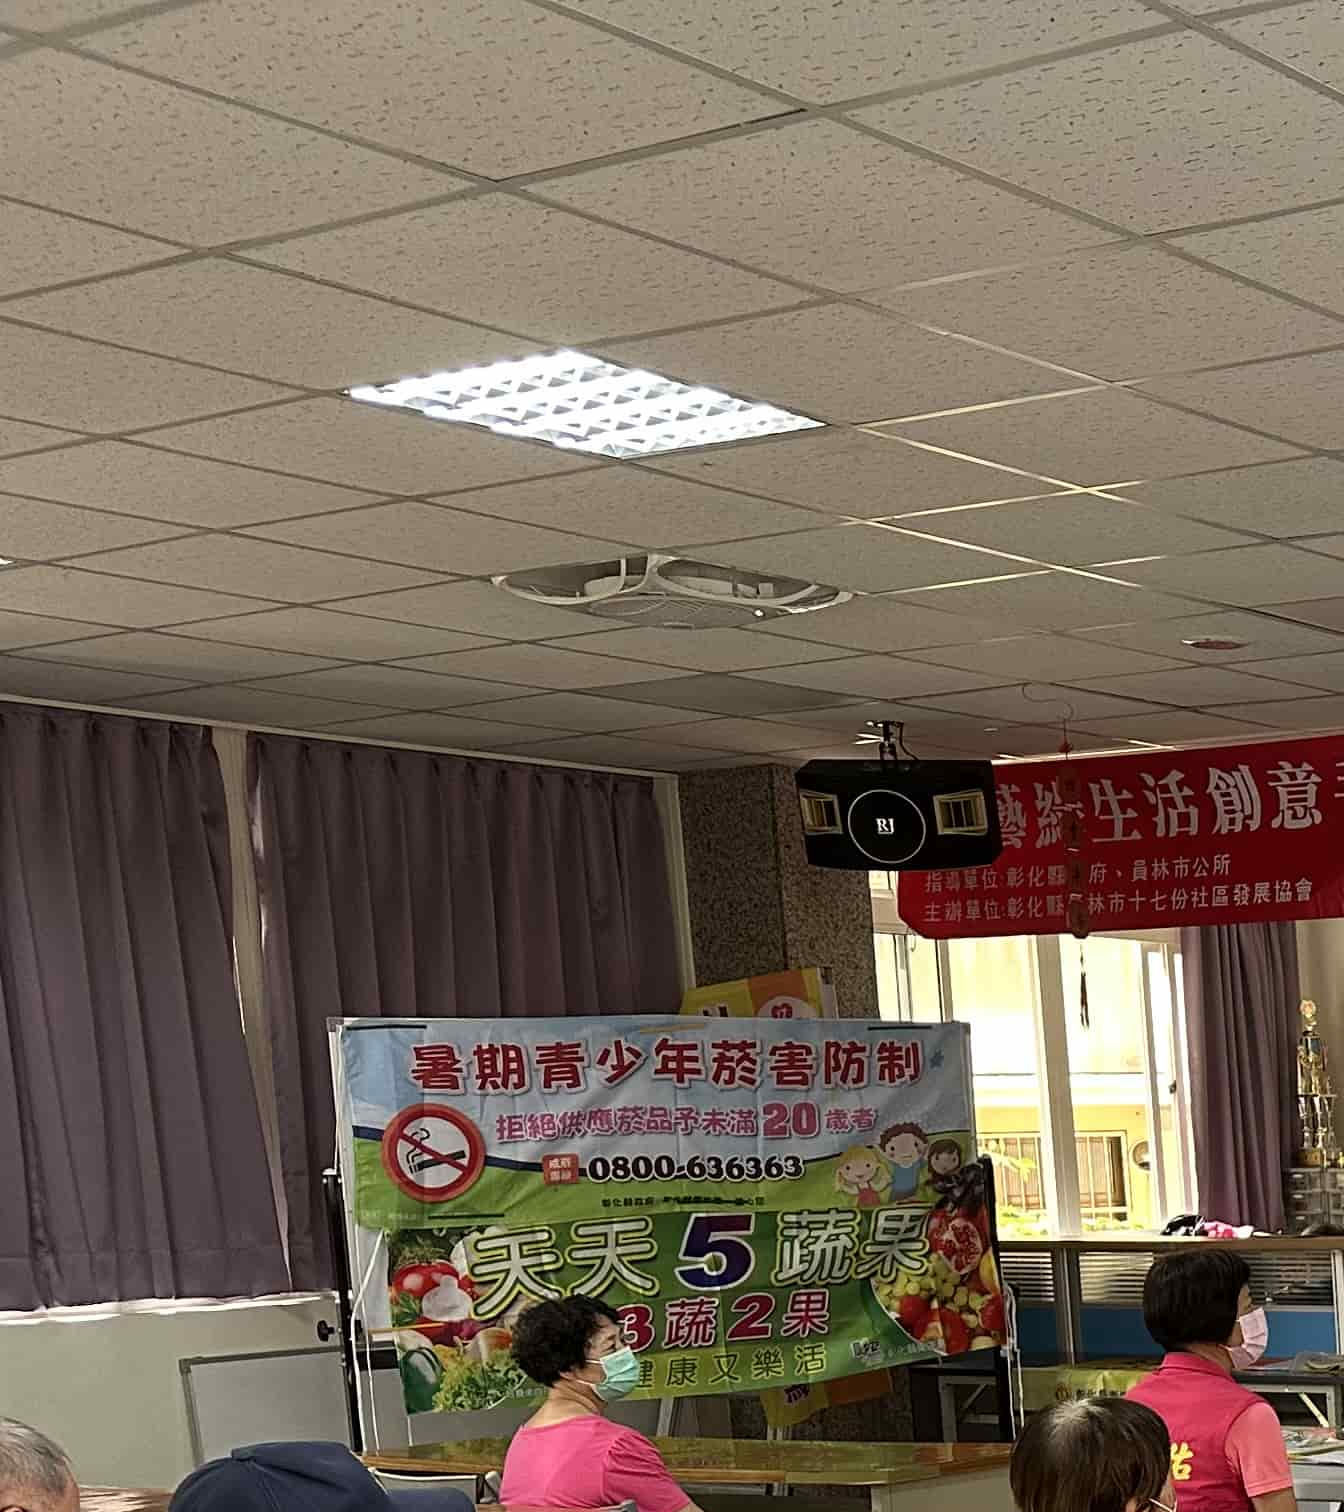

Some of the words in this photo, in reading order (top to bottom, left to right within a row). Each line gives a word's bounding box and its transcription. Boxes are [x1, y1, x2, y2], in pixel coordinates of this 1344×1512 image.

[925, 878, 1313, 923] 主辦單位:彰化縣林市十七份社區發展協會
[410, 1037, 925, 1093] 暑期青少年菸害防制
[586, 1154, 805, 1182] 0800-636363
[467, 1204, 932, 1321] 天天5蔬果
[617, 1288, 830, 1353] 3蔬2果
